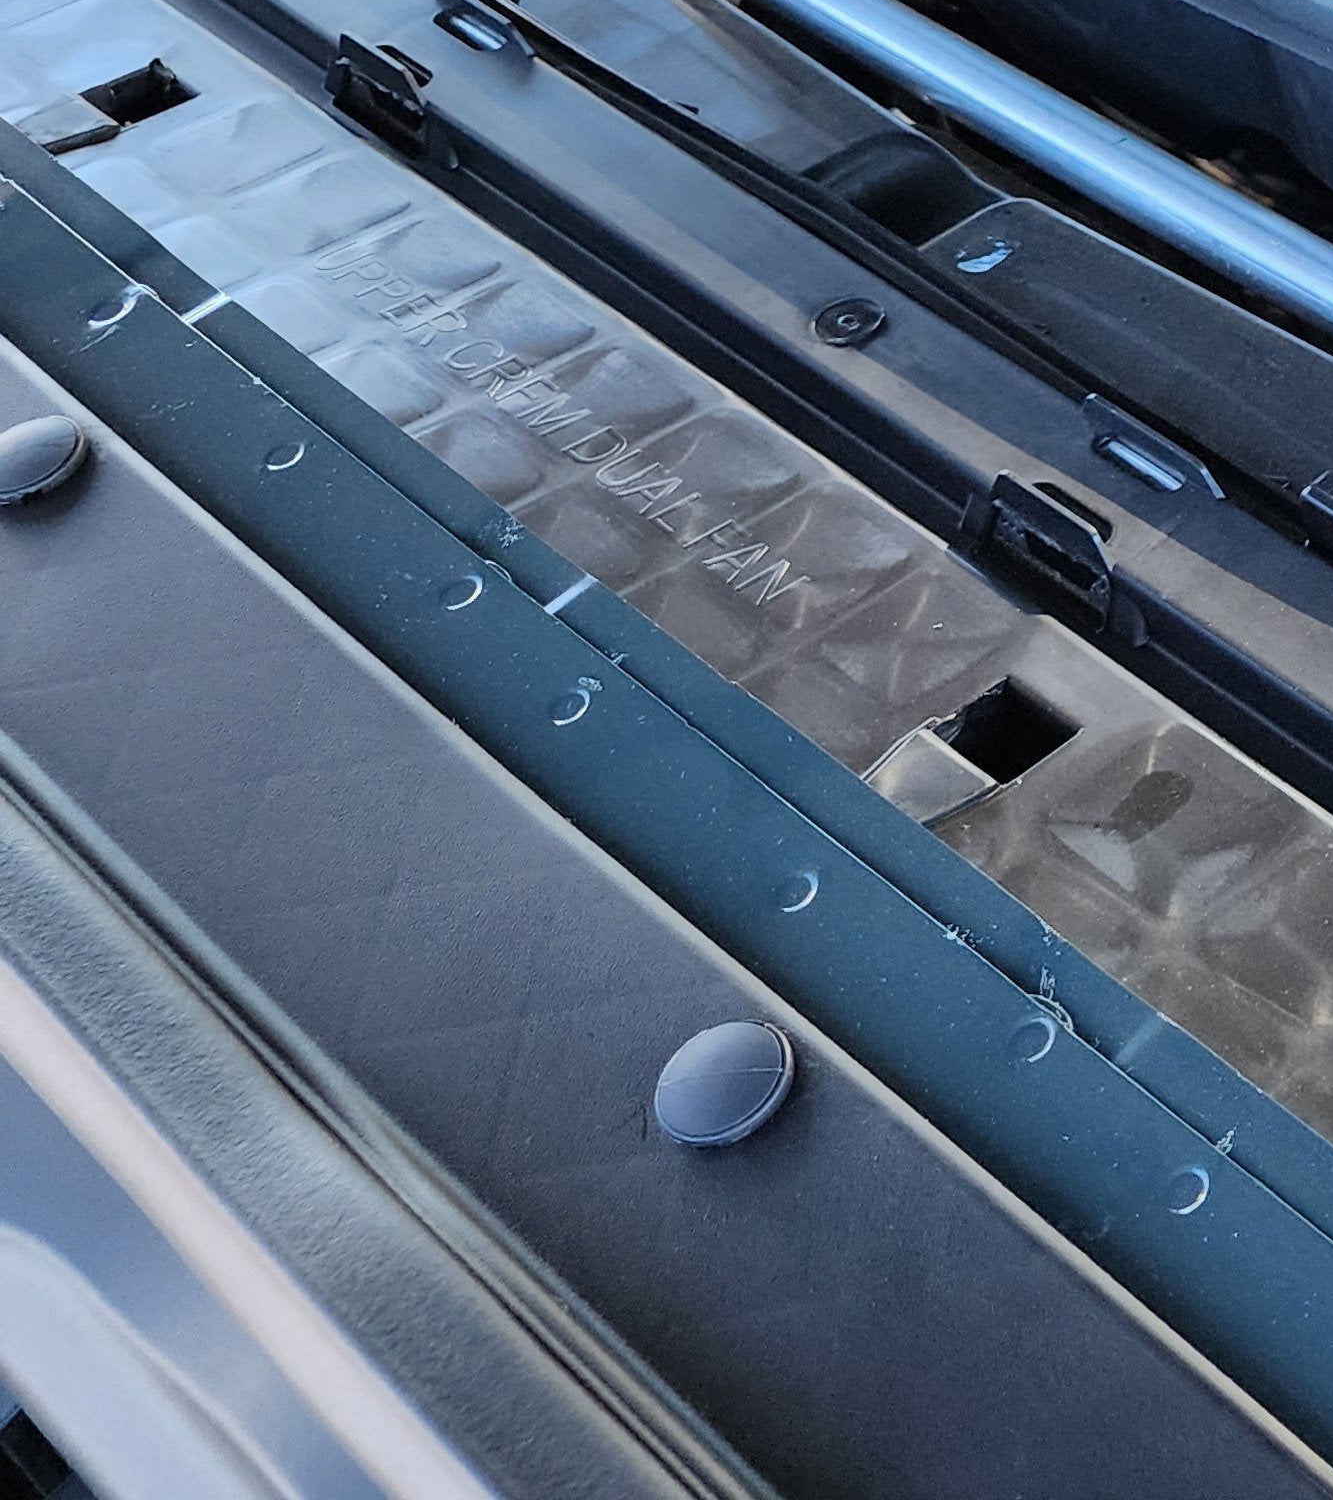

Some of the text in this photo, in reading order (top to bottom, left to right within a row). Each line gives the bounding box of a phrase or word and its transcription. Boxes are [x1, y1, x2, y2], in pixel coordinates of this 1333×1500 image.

[314, 243, 811, 607] UPPER CRFM DUAL FAN
